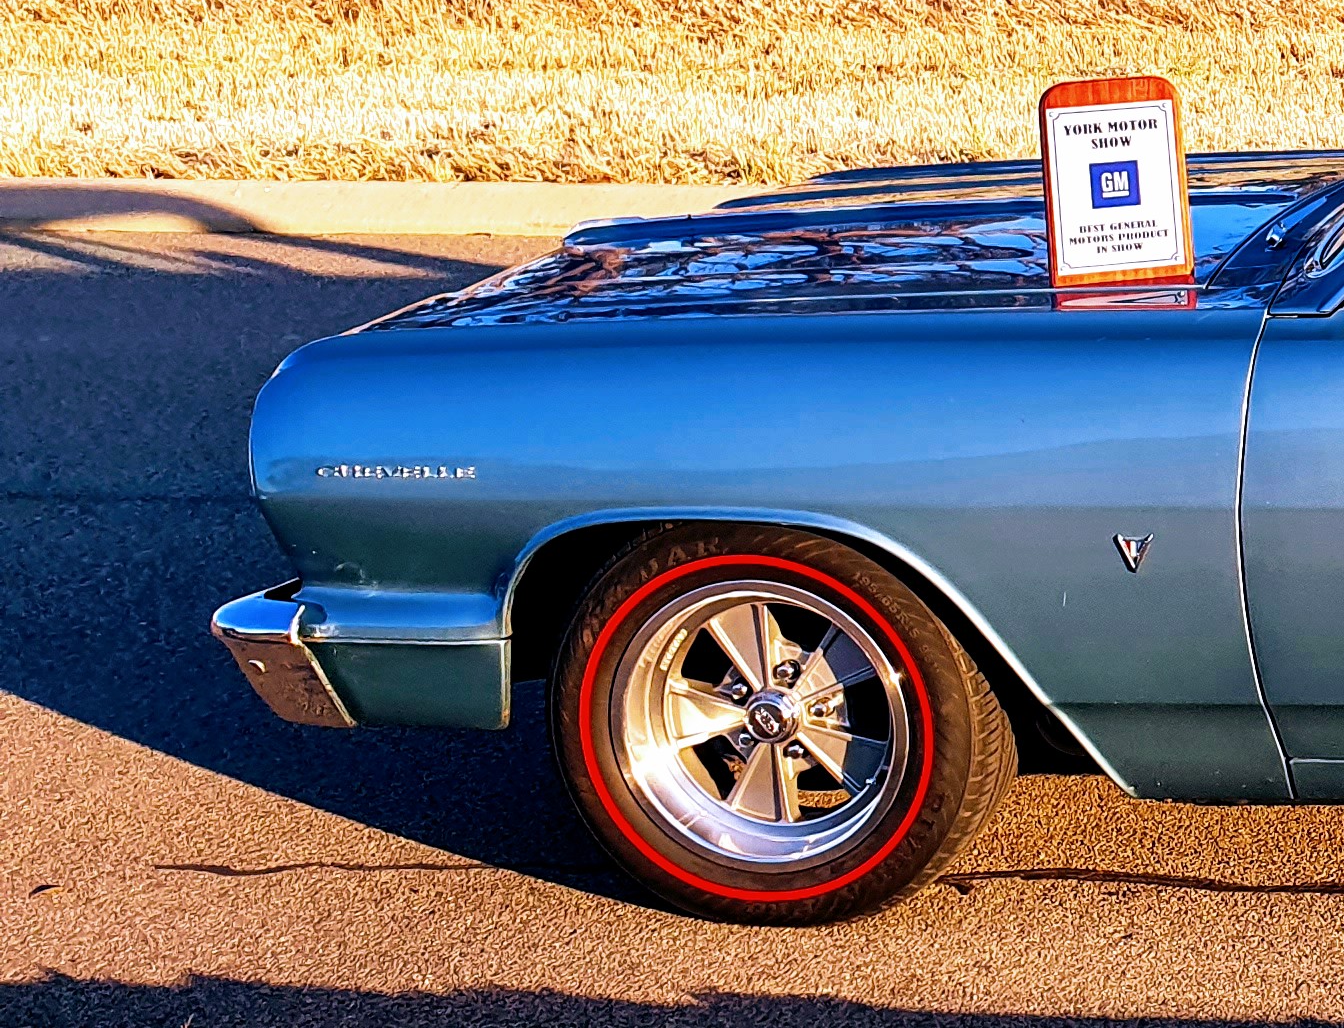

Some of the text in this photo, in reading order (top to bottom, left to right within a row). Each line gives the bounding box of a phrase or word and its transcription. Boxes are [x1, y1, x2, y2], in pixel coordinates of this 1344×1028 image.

[1063, 118, 1158, 136] YORK MOTOR
[1091, 136, 1132, 149] SHOW
[1101, 171, 1129, 192] GM
[1079, 219, 1157, 233] BEST GENERAL
[1069, 229, 1168, 245] MOTORS PRODUCT
[1097, 242, 1143, 254] IN SHOW
[315, 463, 477, 479] CHEVELLE
